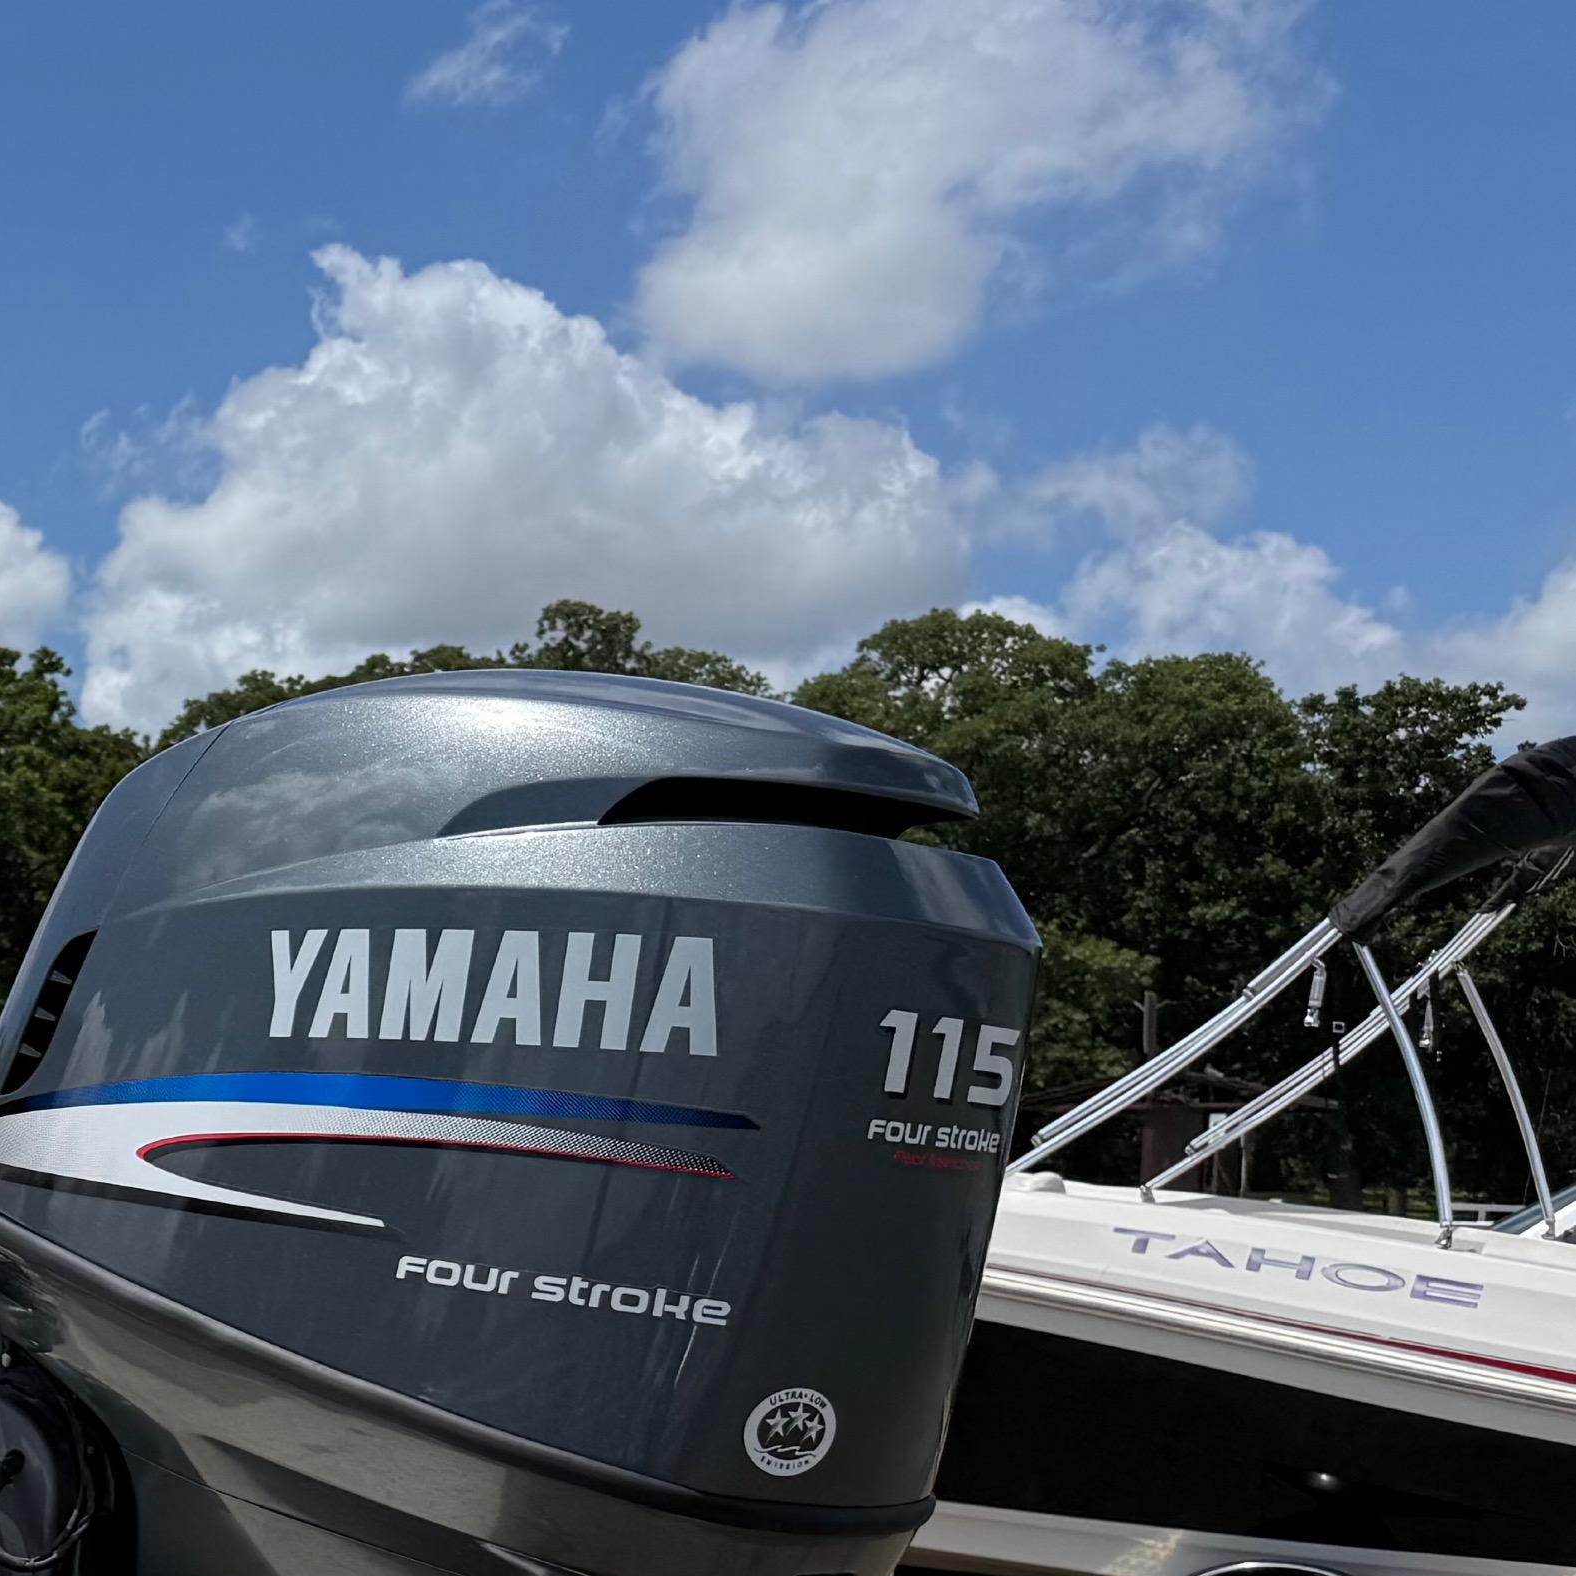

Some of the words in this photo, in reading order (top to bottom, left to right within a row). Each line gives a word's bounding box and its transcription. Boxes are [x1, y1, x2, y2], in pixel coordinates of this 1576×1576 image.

[269, 928, 717, 1057] YAMAHA
[879, 1009, 1021, 1107] 115
[1113, 1226, 1485, 1309] TAHOE
